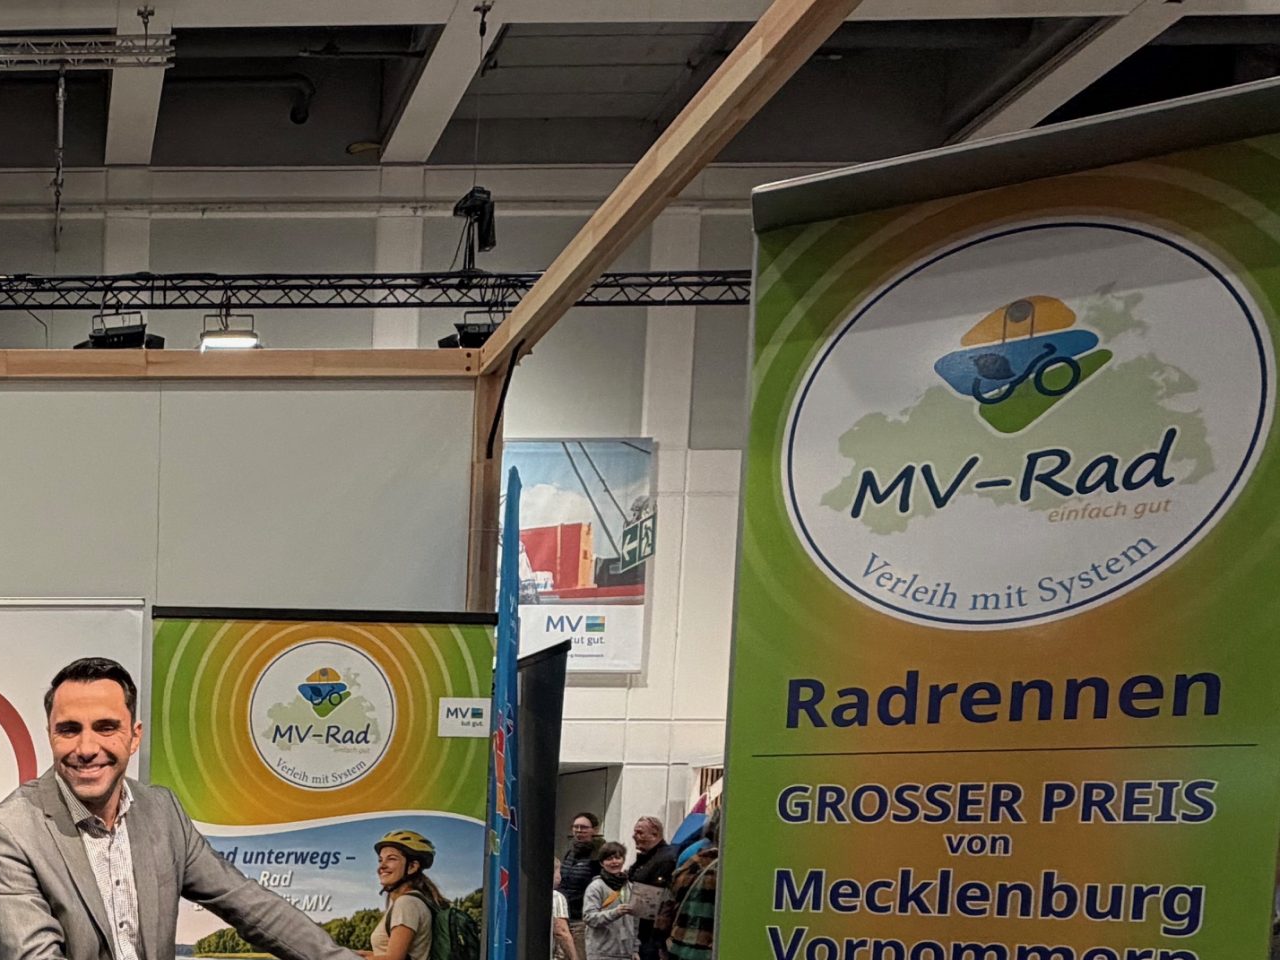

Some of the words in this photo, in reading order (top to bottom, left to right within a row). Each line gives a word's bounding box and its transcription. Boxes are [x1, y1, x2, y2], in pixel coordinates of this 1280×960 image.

[851, 427, 1178, 518] MV-Rad
[1047, 502, 1127, 524] einfach
[1133, 498, 1173, 520] gut
[860, 552, 958, 611] Verleih
[969, 585, 1028, 612] mit
[1038, 535, 1159, 604] System
[546, 615, 584, 633] MV
[587, 636, 606, 646] gut.
[785, 669, 1223, 729] Radrennen
[445, 707, 470, 720] MV
[271, 723, 371, 746] MV-Rad
[276, 757, 310, 784] Verleih
[311, 773, 330, 785] mit
[331, 760, 367, 784] System
[776, 783, 1027, 825] GROSSER
[1040, 779, 1219, 825] PREIS
[944, 834, 1012, 856] von
[242, 848, 342, 869] unterwegs
[258, 870, 293, 888] Rad
[301, 895, 333, 912] MV.
[773, 868, 1206, 937] Mecklenburg
